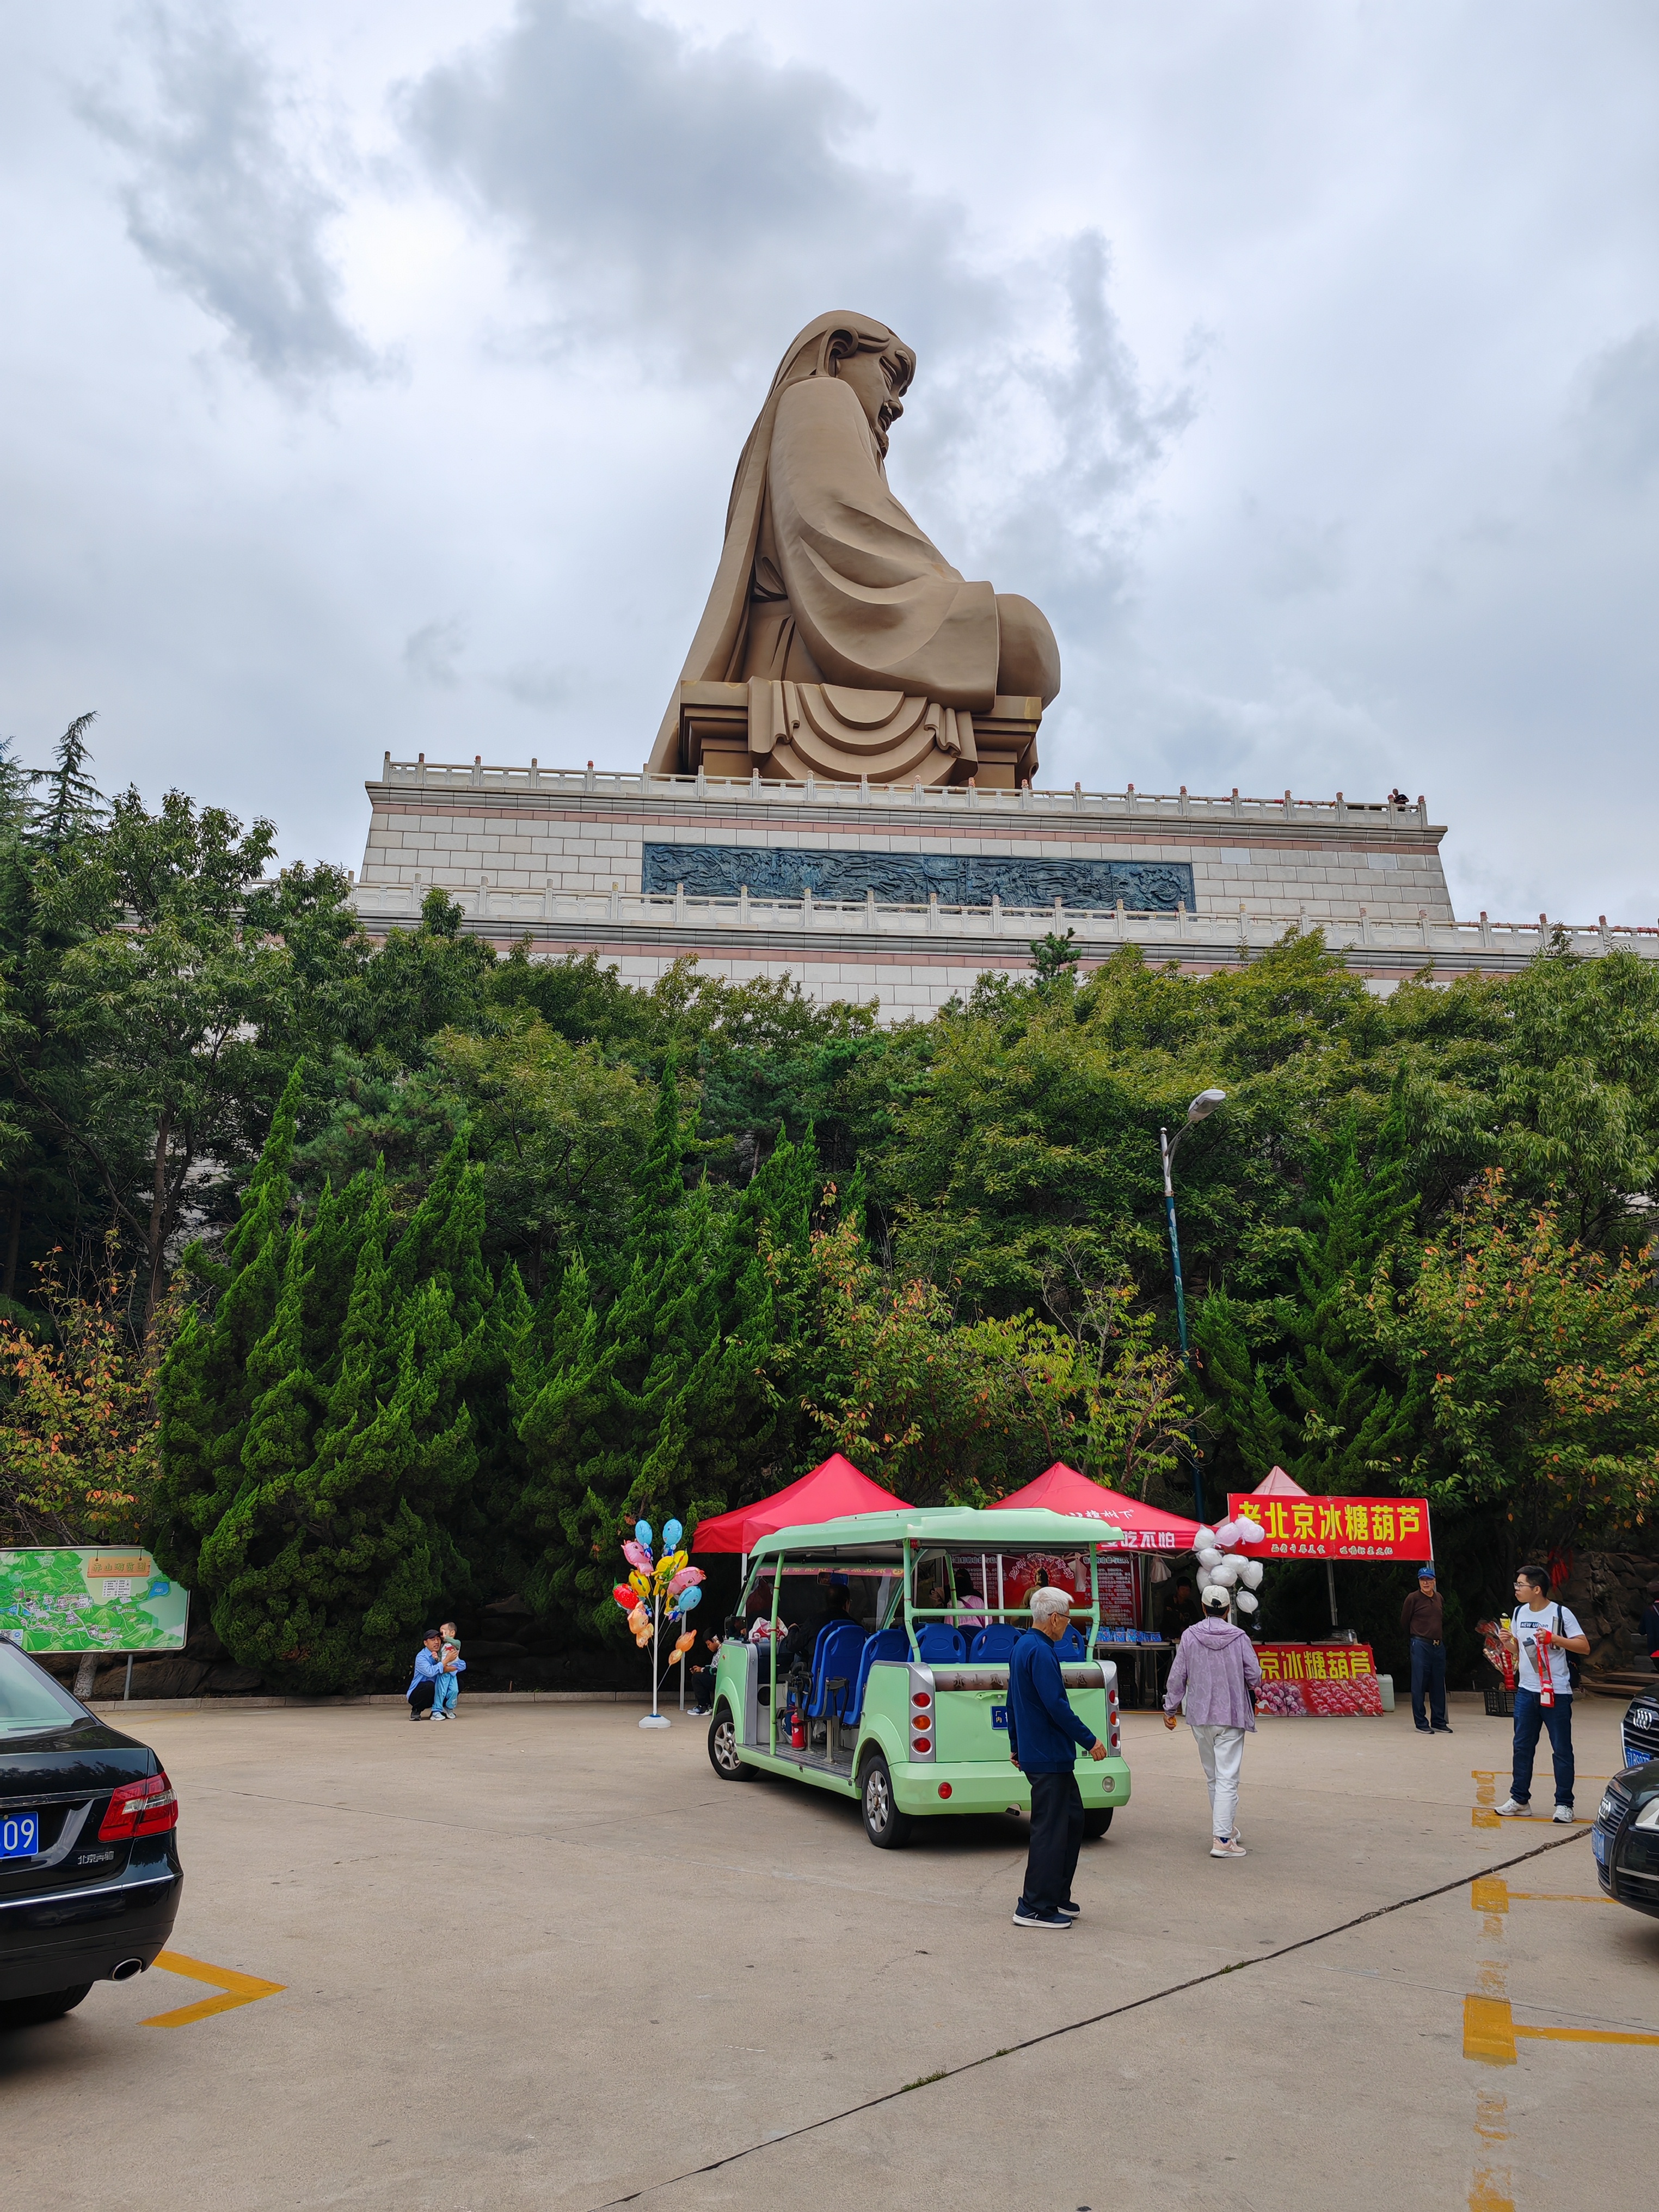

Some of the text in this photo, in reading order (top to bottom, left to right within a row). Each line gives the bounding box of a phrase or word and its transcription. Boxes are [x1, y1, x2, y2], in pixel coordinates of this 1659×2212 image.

[1238, 1500, 1421, 1543] 老北京冰糖葫芦
